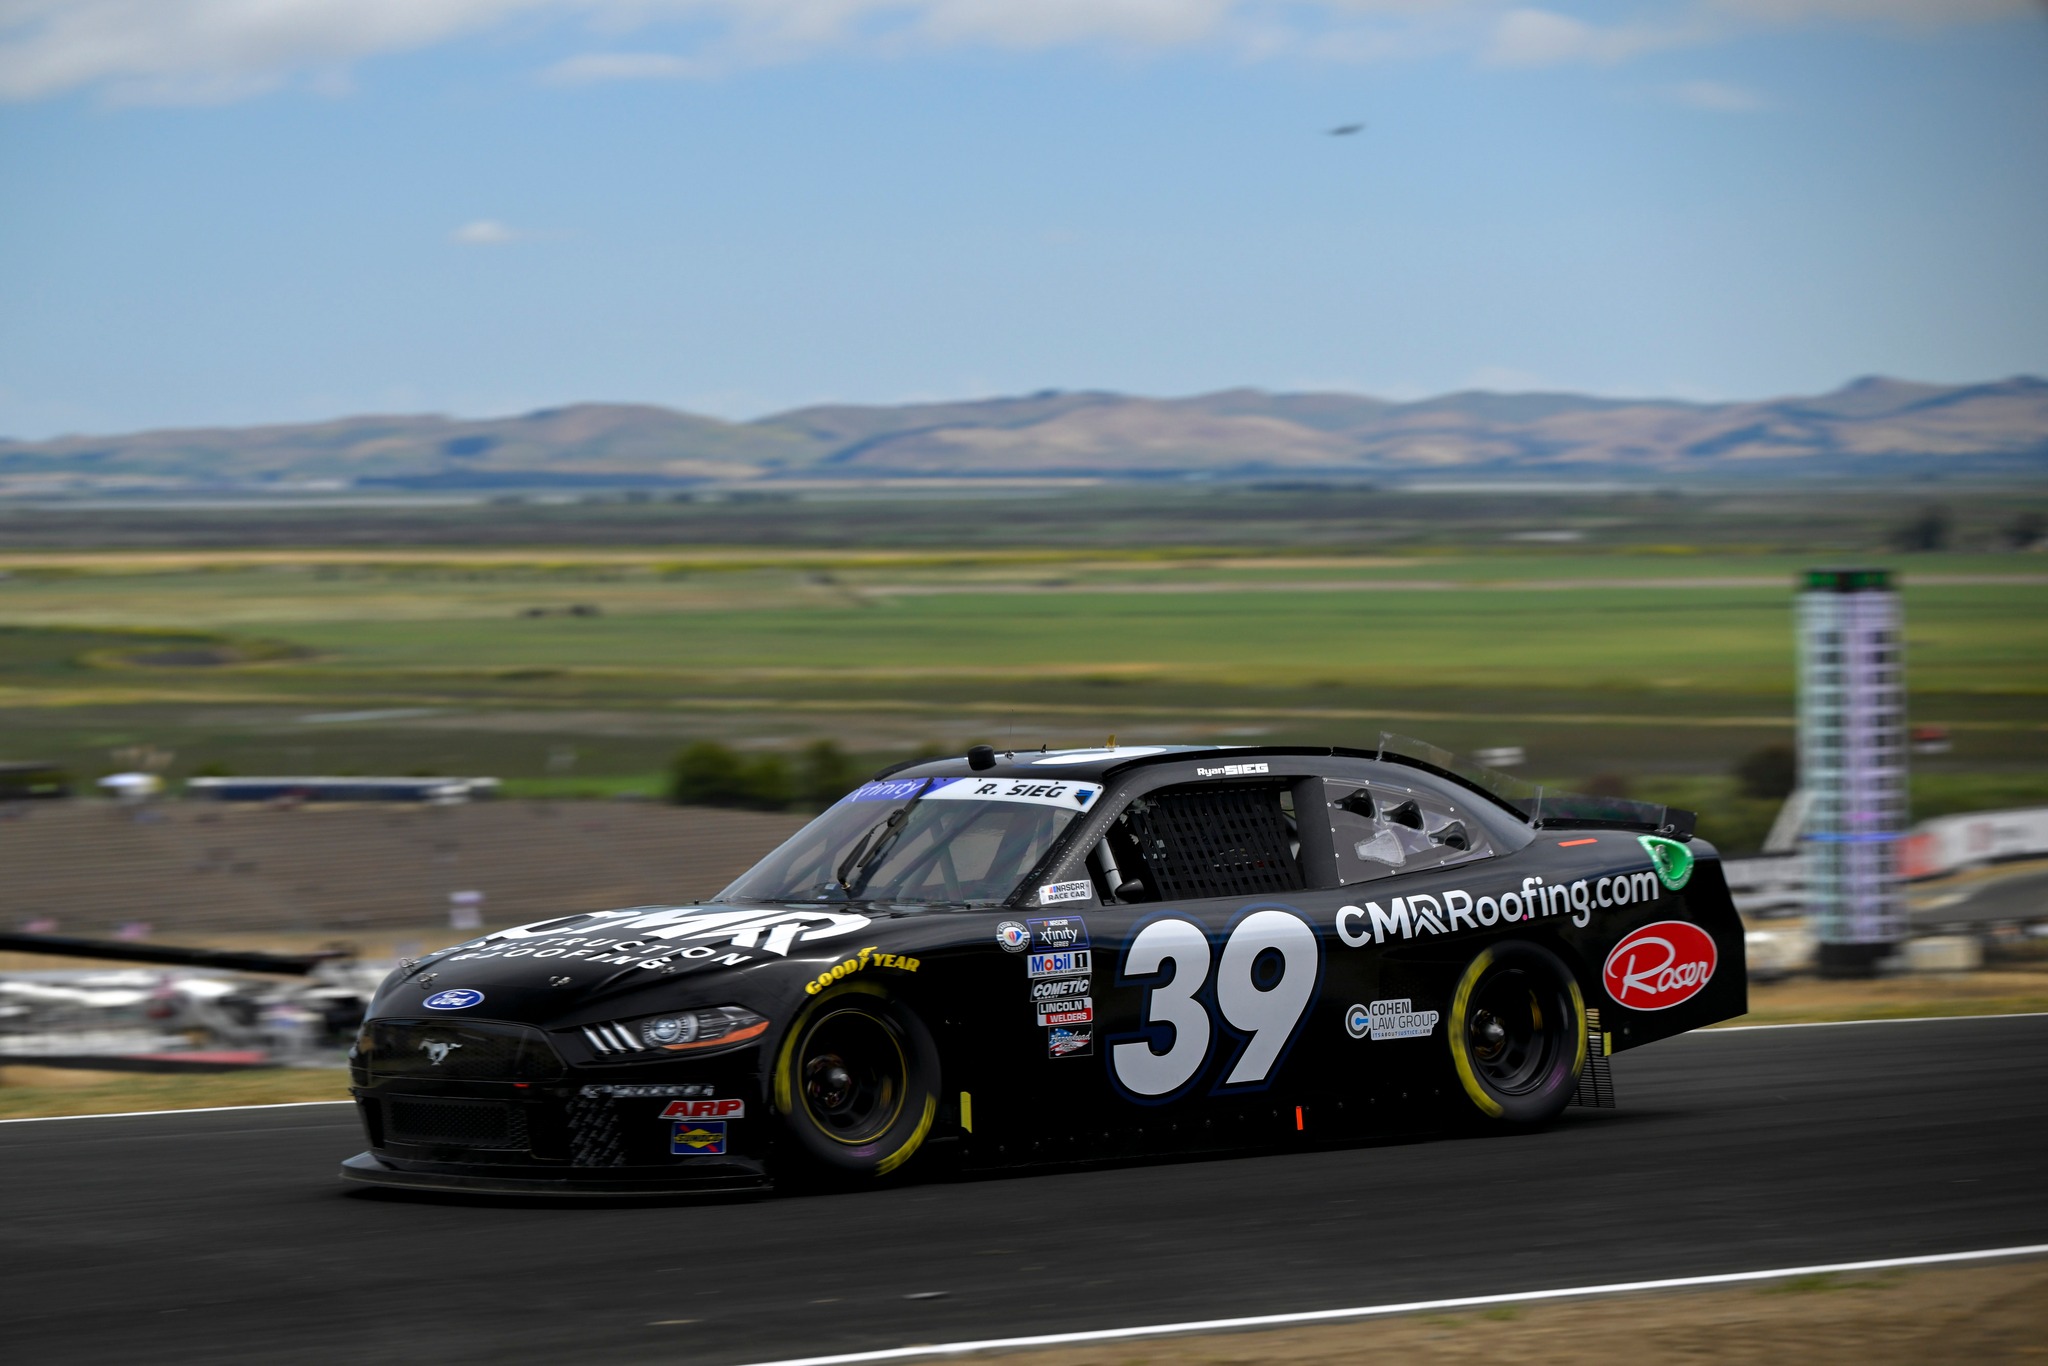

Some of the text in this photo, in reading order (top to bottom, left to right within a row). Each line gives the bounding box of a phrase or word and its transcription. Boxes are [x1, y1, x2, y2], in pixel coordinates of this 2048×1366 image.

[850, 780, 925, 802] xfinity
[973, 783, 1067, 798] R. SIEG
[1055, 882, 1085, 893] NASCAR
[1048, 891, 1086, 901] RACE CAR
[1040, 927, 1078, 945] xfinity
[1053, 940, 1070, 948] SERIES
[1031, 953, 1071, 972] Mobil
[1033, 979, 1089, 997] COMETIC
[1040, 1001, 1082, 1014] LINCOLN
[1113, 910, 1319, 1096] 39
[1371, 1001, 1410, 1016] COHEN
[1050, 1012, 1087, 1023] WELDERS
[1372, 1013, 1438, 1030] LAW GROUP
[664, 1100, 741, 1117] ARP
